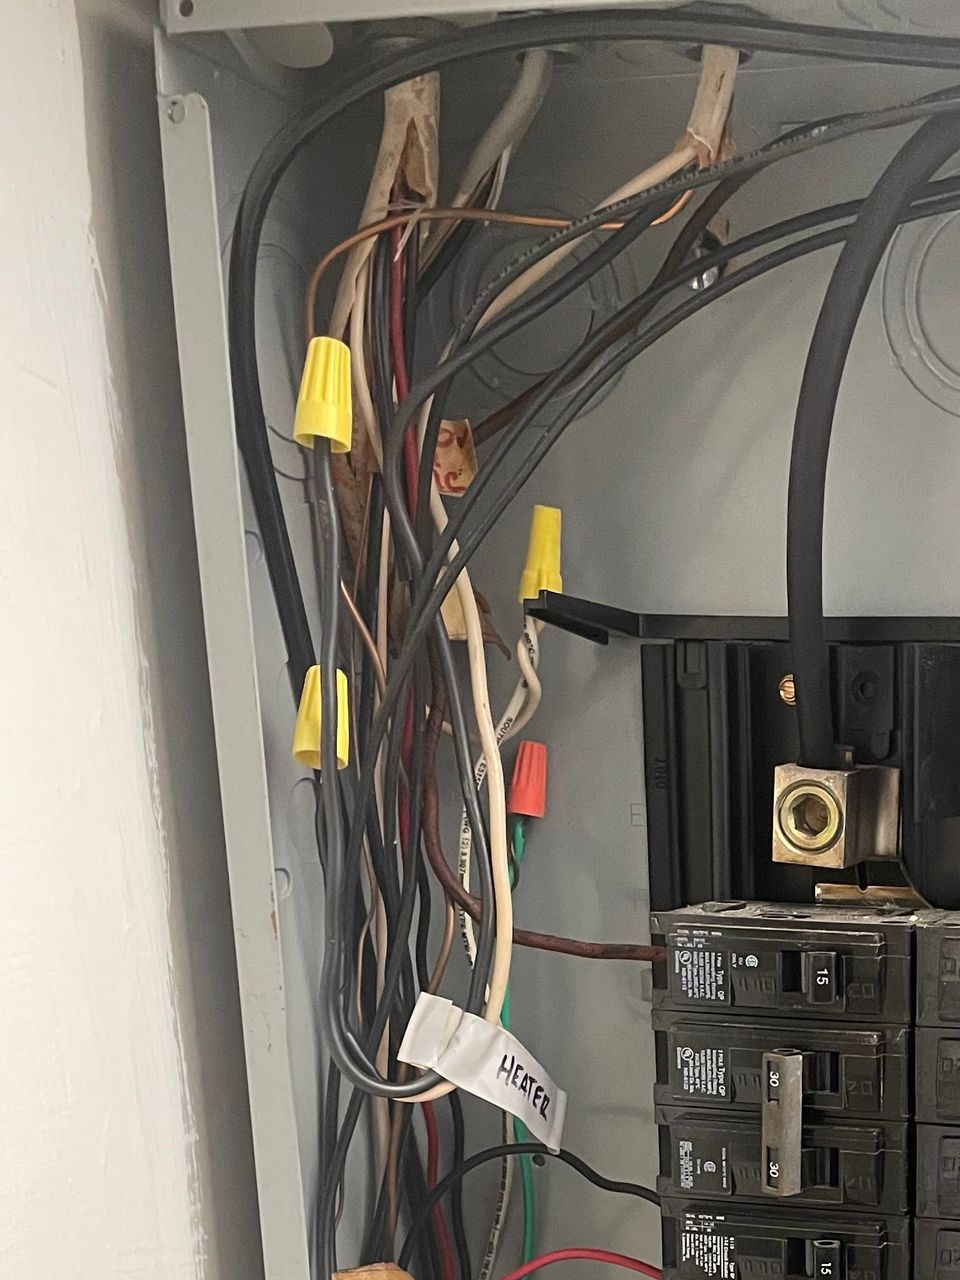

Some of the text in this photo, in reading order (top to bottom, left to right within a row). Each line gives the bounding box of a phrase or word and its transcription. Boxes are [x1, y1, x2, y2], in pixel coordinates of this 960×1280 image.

[816, 968, 830, 986] 15
[496, 1051, 552, 1122] HEATER
[770, 1071, 780, 1087] 30
[769, 1160, 780, 1178] 30
[820, 1262, 832, 1276] 15
